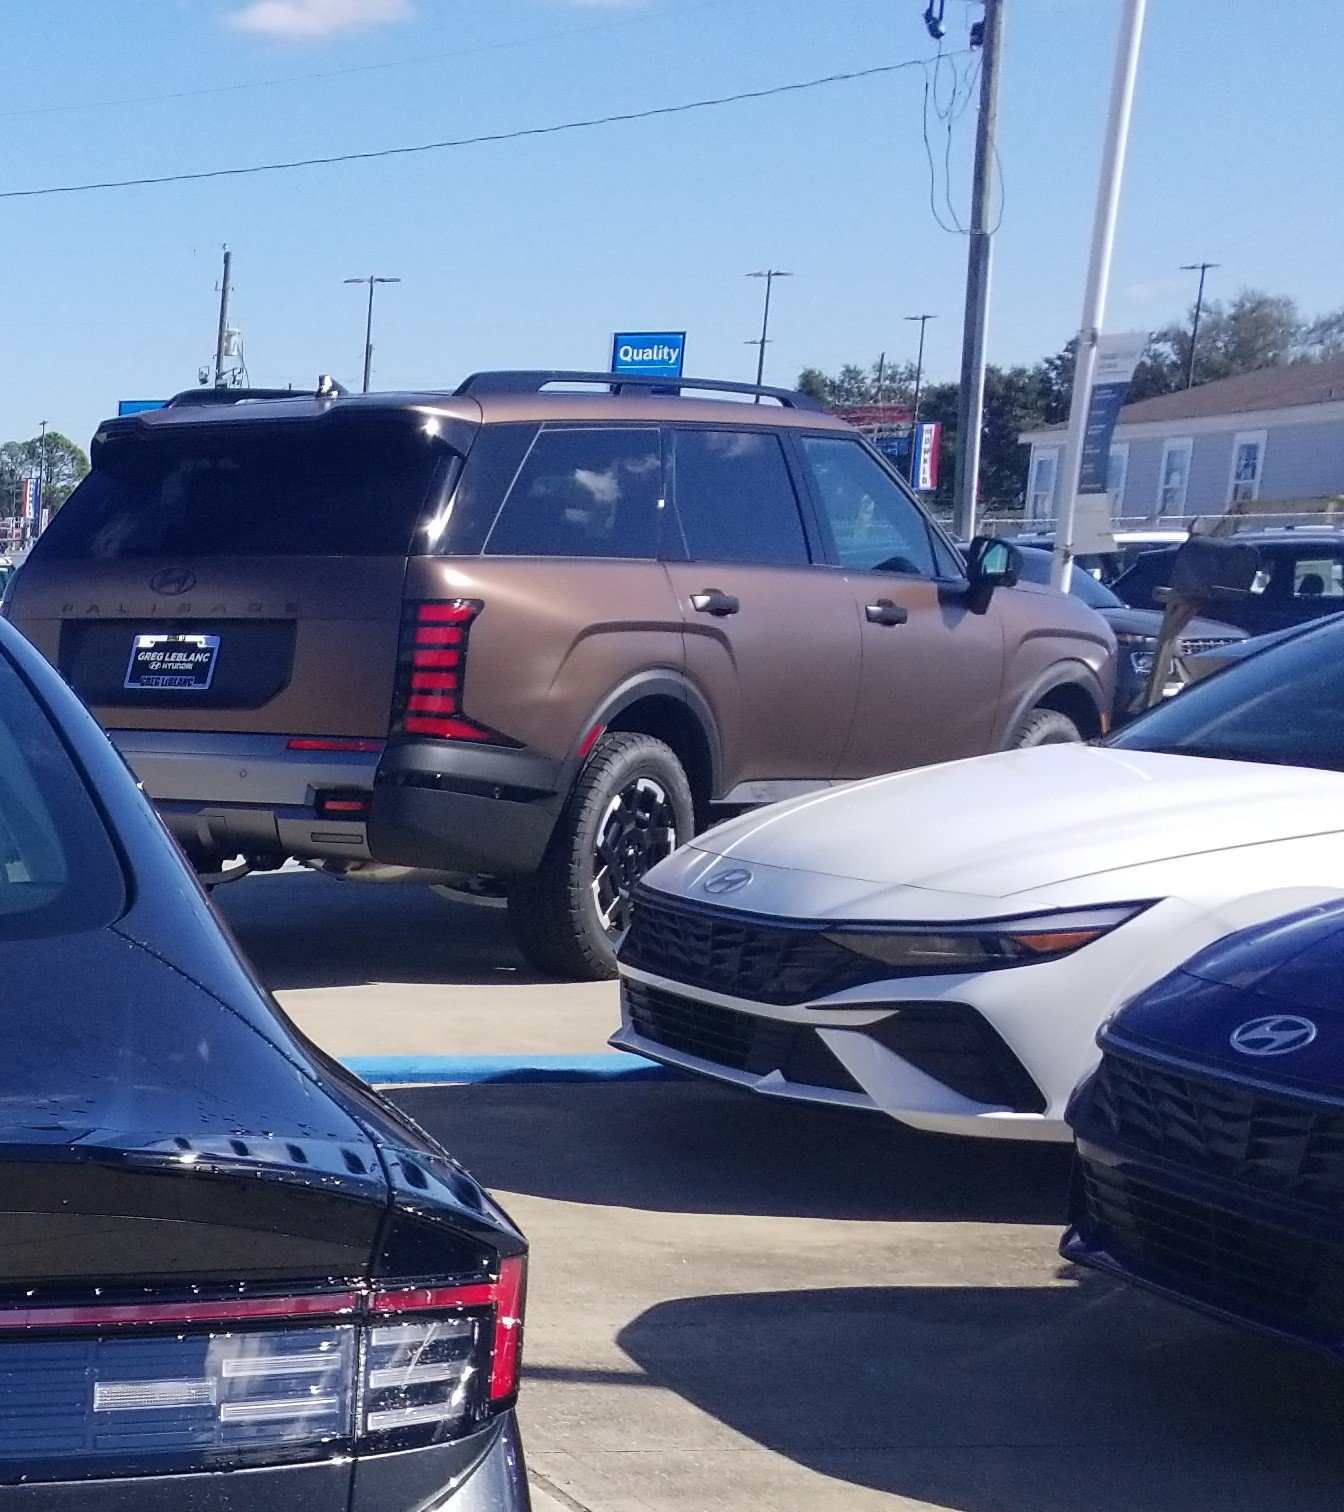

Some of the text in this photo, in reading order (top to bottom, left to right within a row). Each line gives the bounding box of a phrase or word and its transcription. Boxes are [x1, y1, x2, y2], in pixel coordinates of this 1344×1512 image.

[619, 344, 680, 364] Quality
[61, 601, 300, 615] PALISADE
[137, 651, 211, 663] GREG LEBLANC
